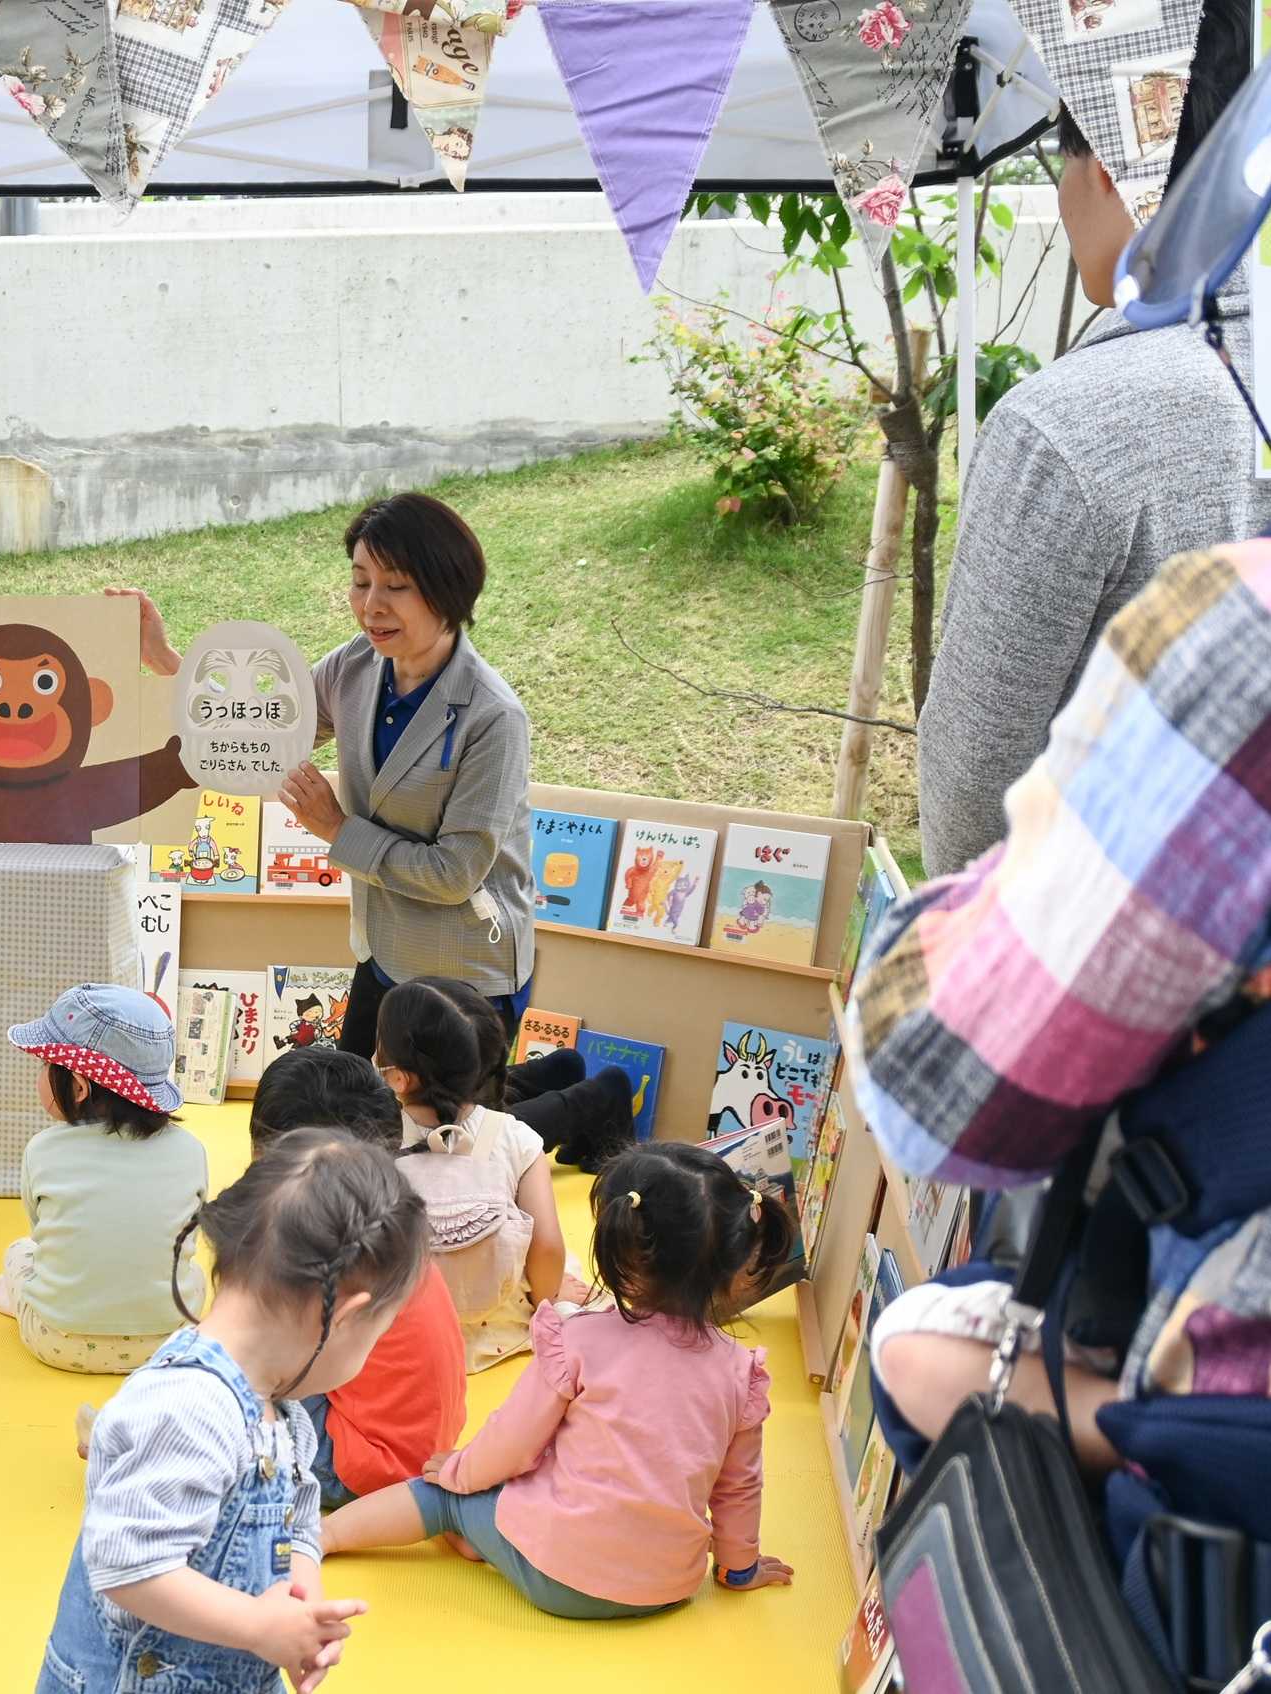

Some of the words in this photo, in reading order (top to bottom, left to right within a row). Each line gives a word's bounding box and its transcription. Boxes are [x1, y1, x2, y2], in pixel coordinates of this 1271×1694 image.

[199, 700, 282, 721] うっほっほ
[209, 739, 271, 754] ちからもちの
[199, 757, 247, 772] ごりらさん
[251, 757, 285, 773] でした。
[536, 817, 604, 837] たまごやきくん
[635, 830, 679, 845] けんけん
[754, 845, 793, 863] はぐ
[140, 915, 170, 933] むし
[240, 992, 260, 1056] ひまわり
[586, 1038, 650, 1067] バナナです
